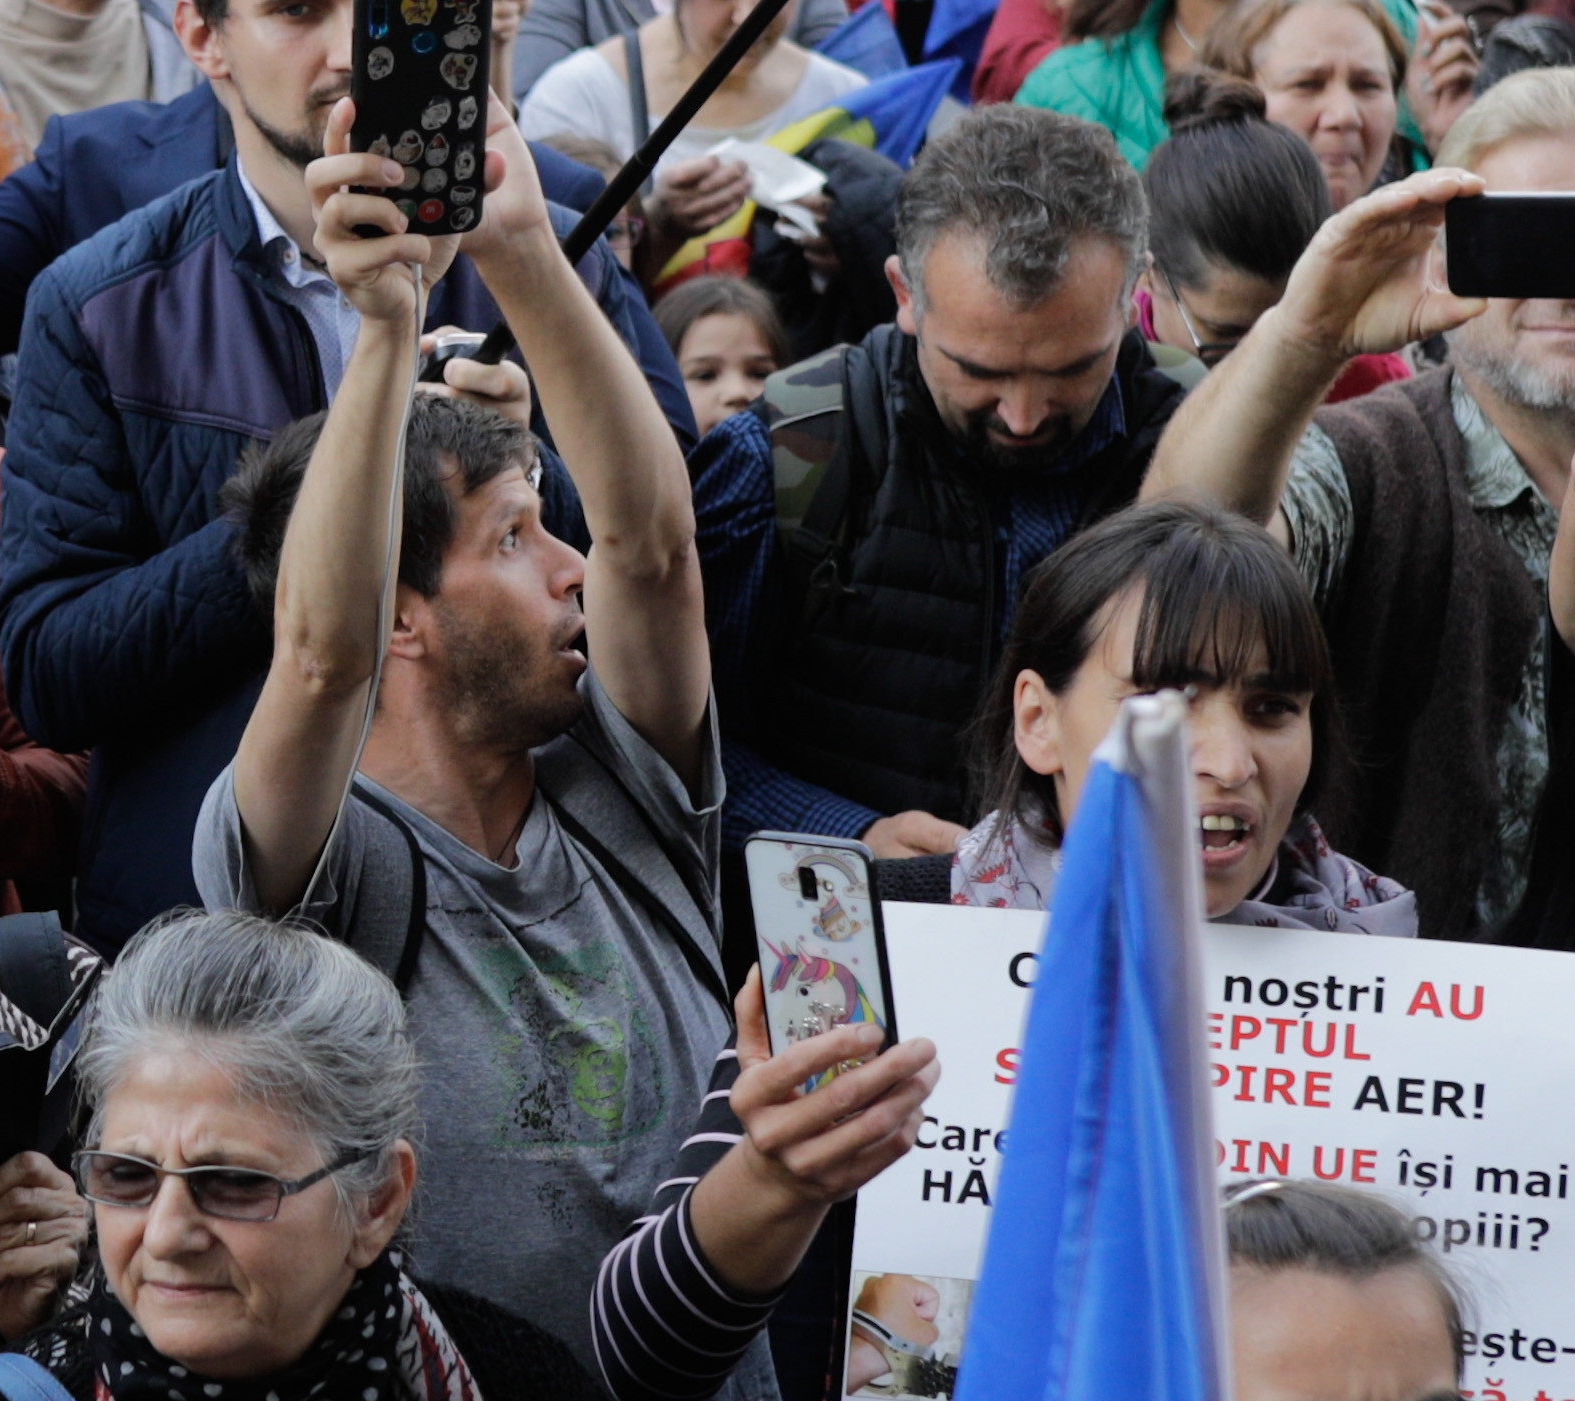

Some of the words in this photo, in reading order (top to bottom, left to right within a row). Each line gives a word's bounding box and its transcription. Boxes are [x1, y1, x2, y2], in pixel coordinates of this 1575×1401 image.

[1225, 974, 1386, 1019] noștri
[1407, 981, 1485, 1021] AU
[1208, 1012, 1371, 1061] EPTUL
[1353, 1075, 1486, 1120] AER!
[1313, 1146, 1377, 1183] UE
[1397, 1150, 1454, 1197] își
[1475, 1163, 1569, 1198] mai
[1411, 1211, 1550, 1253] opiii?
